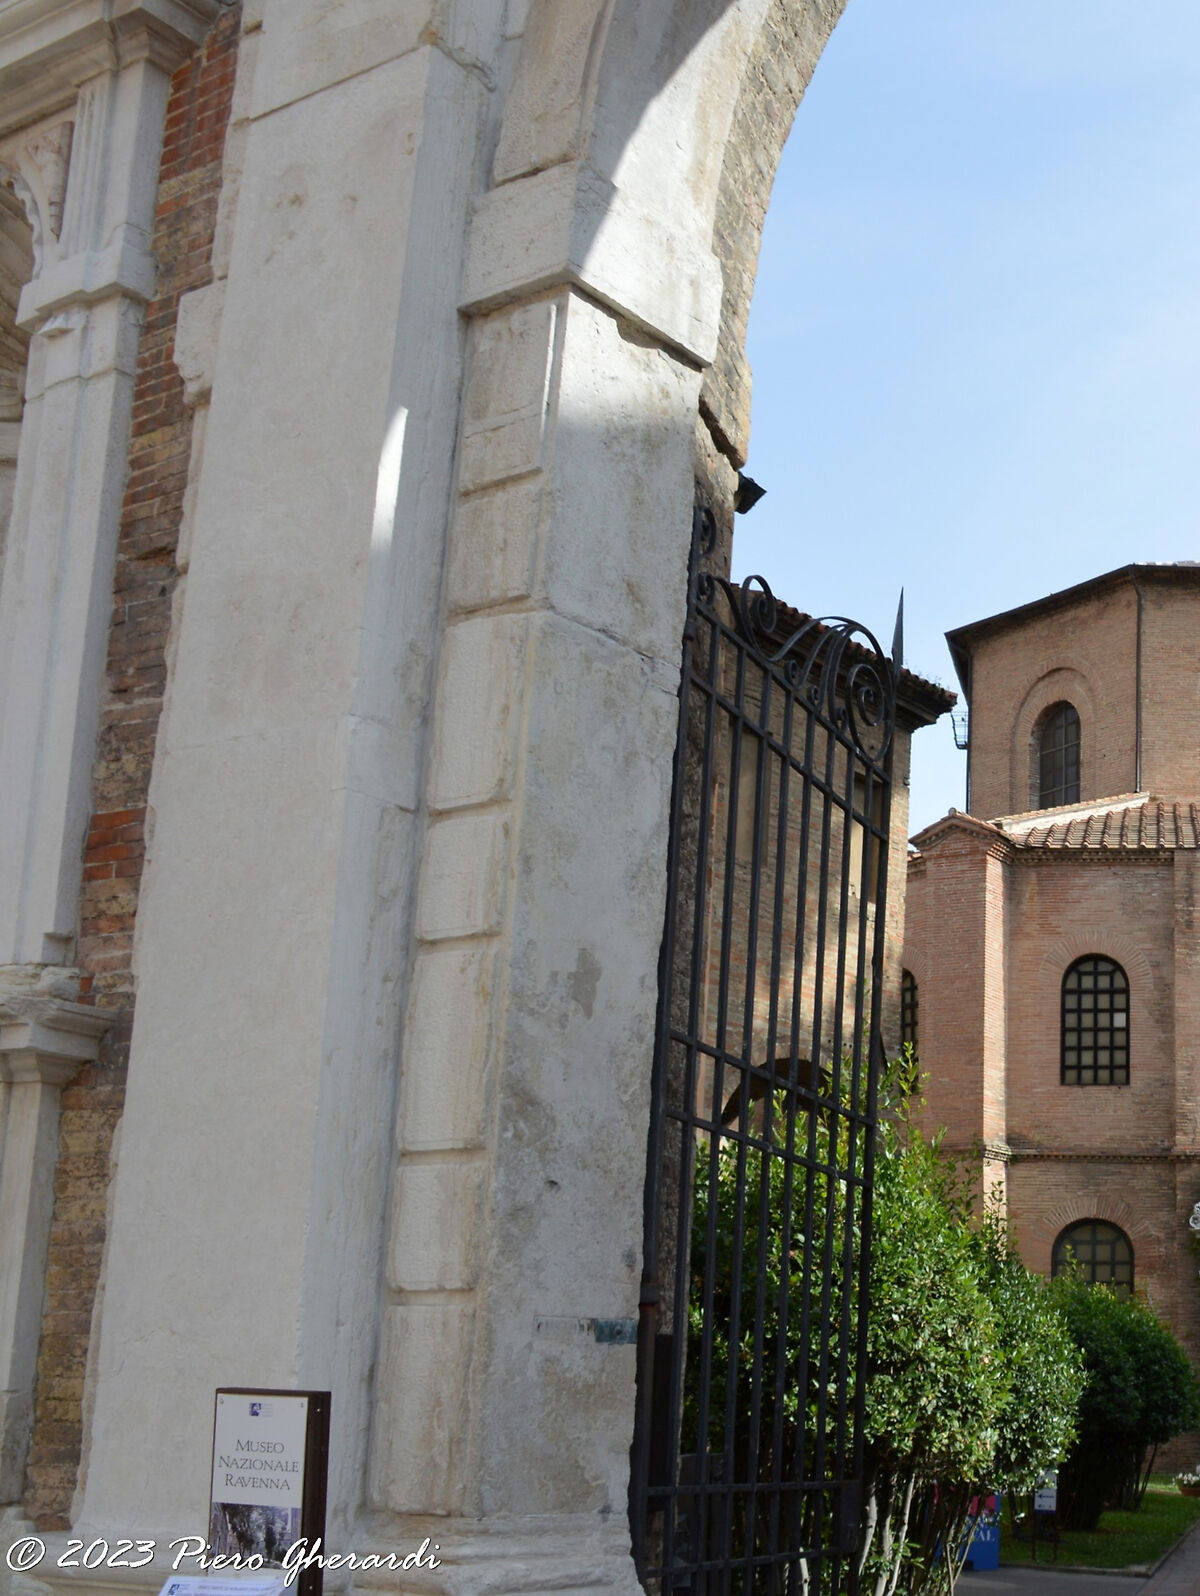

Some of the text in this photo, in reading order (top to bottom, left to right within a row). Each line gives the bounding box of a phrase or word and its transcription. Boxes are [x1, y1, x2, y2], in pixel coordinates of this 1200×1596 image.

[235, 1439, 285, 1454] MUSEO
[218, 1455, 299, 1473] NAZIONALE
[225, 1473, 290, 1491] RAVENNA
